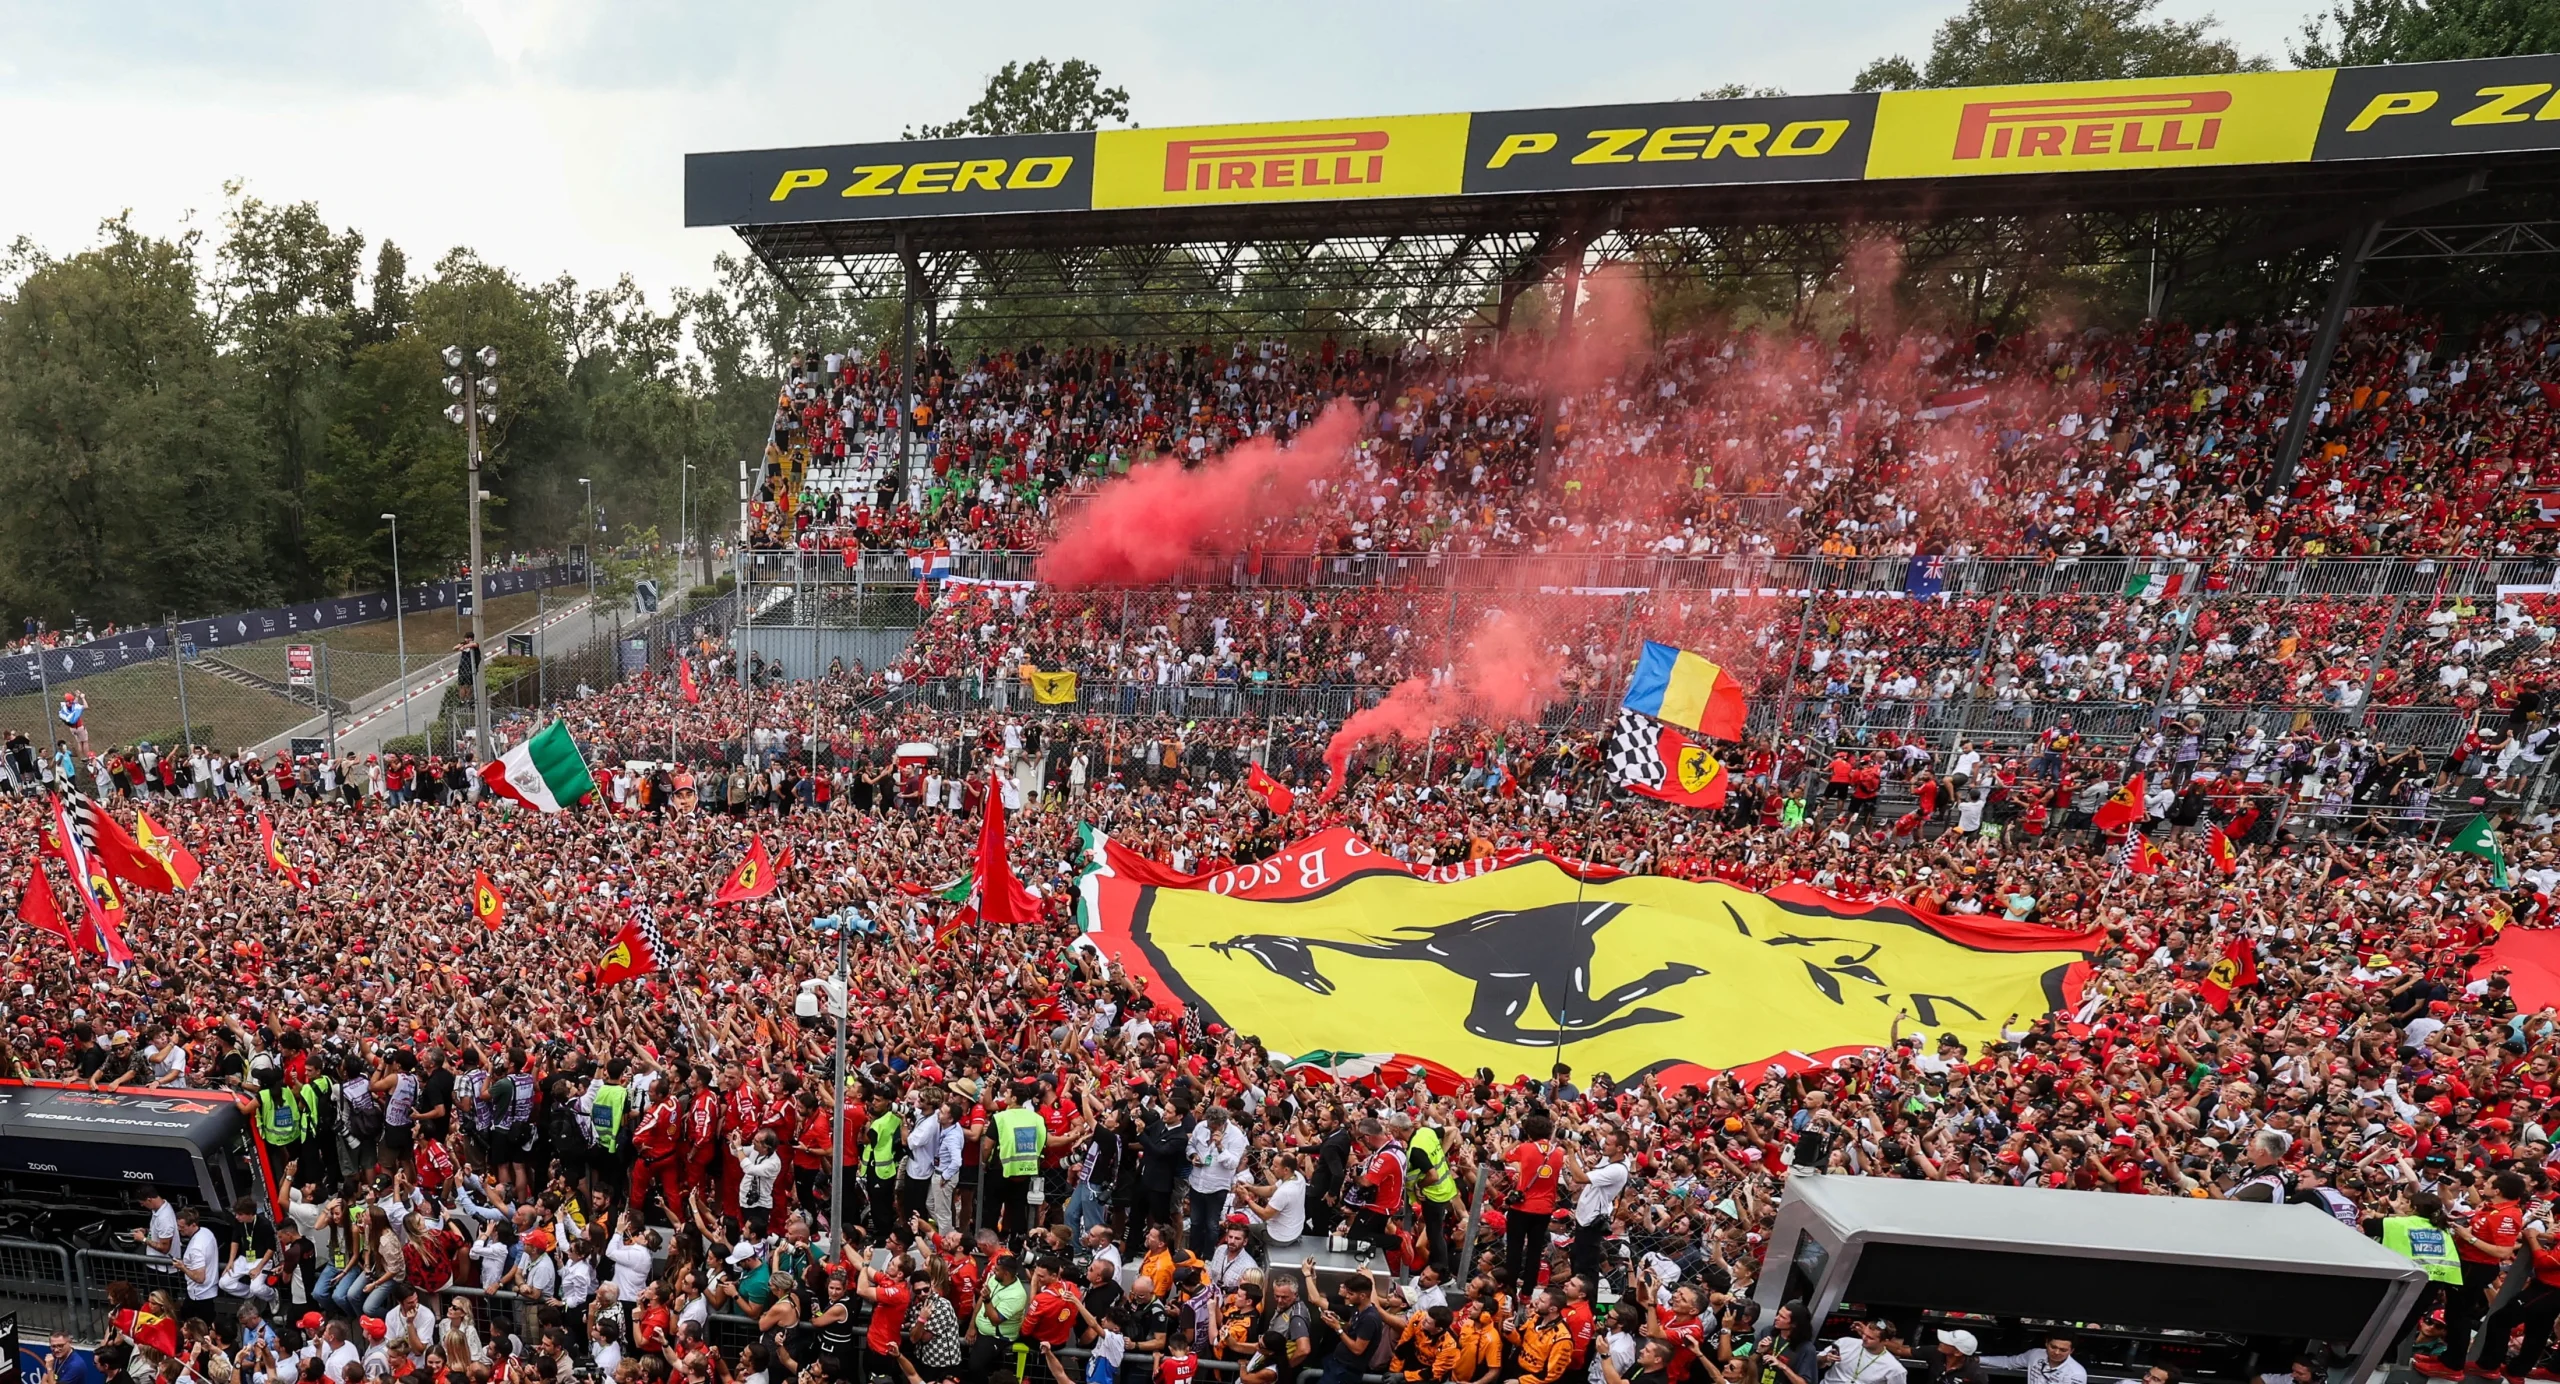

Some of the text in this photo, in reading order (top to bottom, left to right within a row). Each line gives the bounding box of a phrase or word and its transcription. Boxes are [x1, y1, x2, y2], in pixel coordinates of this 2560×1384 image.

[1952, 91, 2233, 160] PIRELLI
[2345, 90, 2439, 132] P
[1163, 131, 1390, 192] PIRELLI
[1486, 120, 1850, 168] P ZERO
[770, 156, 1074, 201] P ZERO
[64, 1091, 128, 1100] ORACLE
[24, 1112, 191, 1129] REDBULLRACING.COM
[28, 1162, 58, 1172] zoom
[122, 1170, 154, 1181] zoom
